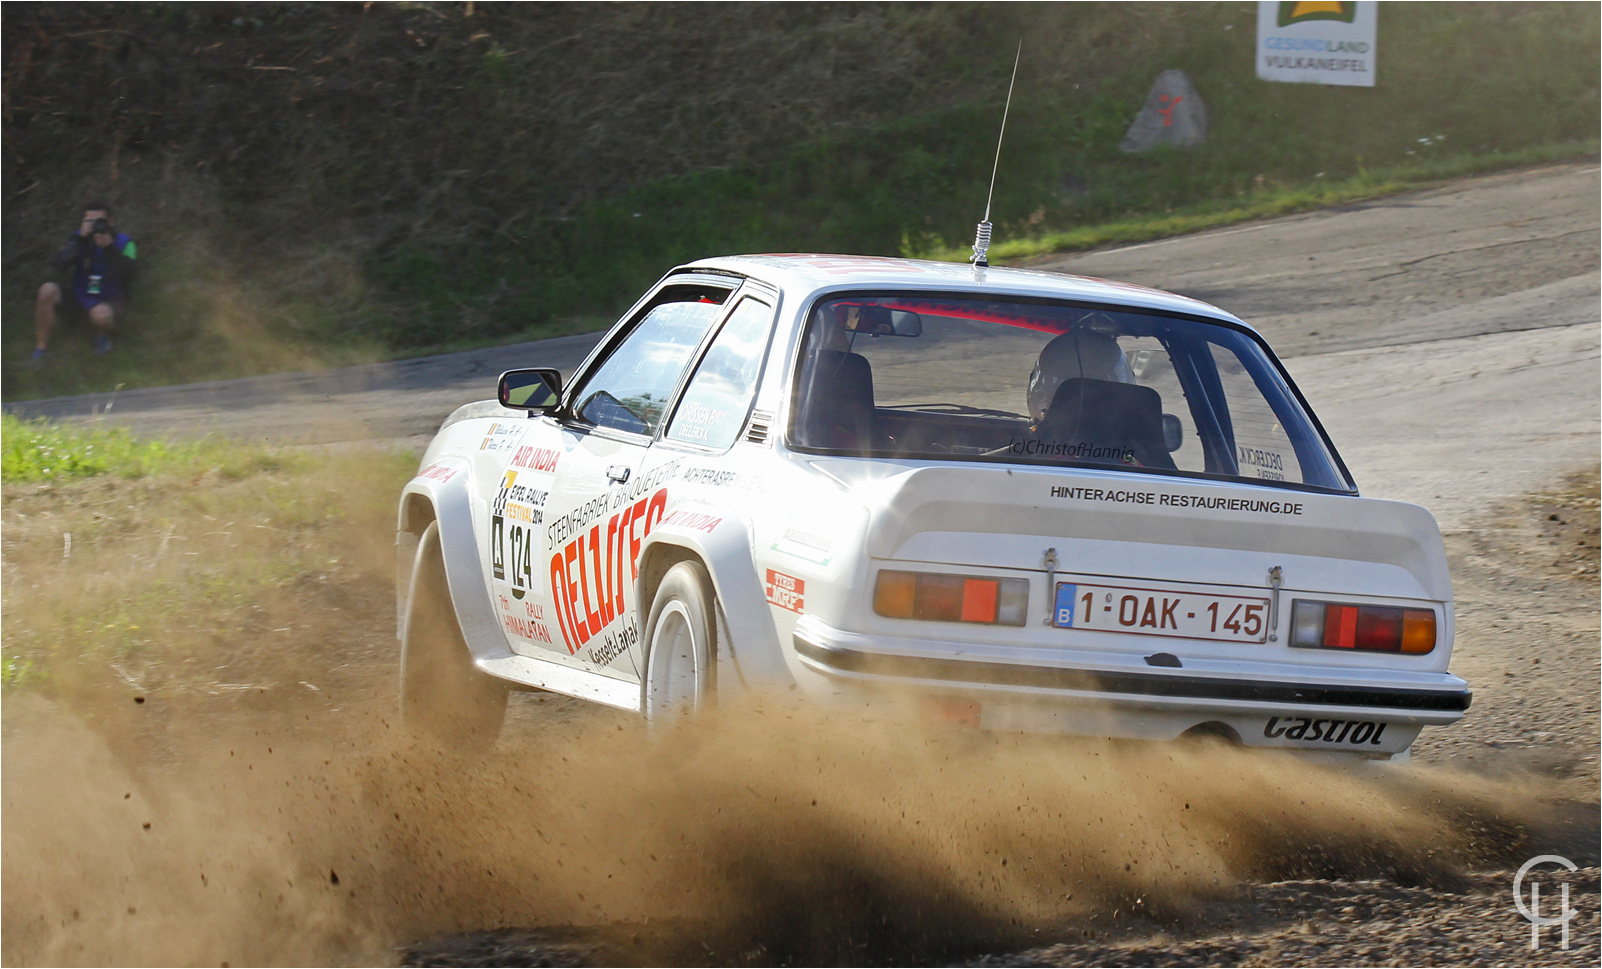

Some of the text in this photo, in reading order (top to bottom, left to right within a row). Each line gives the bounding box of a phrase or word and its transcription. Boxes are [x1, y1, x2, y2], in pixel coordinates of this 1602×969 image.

[1263, 37, 1370, 53] GESUNDLAND
[1264, 56, 1368, 72] VULKANEIFEL
[510, 445, 534, 468] AIR
[528, 447, 561, 473] INDIA
[510, 484, 549, 507] EIFEL RALLYE
[548, 456, 686, 551] STEENFABRIEK BRIQUETERIE
[1051, 485, 1303, 516] HINTERACHSE RESTAURIERUNG.DE
[505, 502, 544, 525] FESTIVAL 2014
[659, 510, 723, 533] AIR INDIA
[509, 524, 532, 590] 124
[774, 572, 796, 591] TYRES
[772, 584, 800, 609] MRF
[525, 601, 544, 620] RALLY
[1058, 609, 1070, 623] B
[503, 614, 552, 644] HIMALAYAN
[1263, 716, 1387, 745] Castrol
